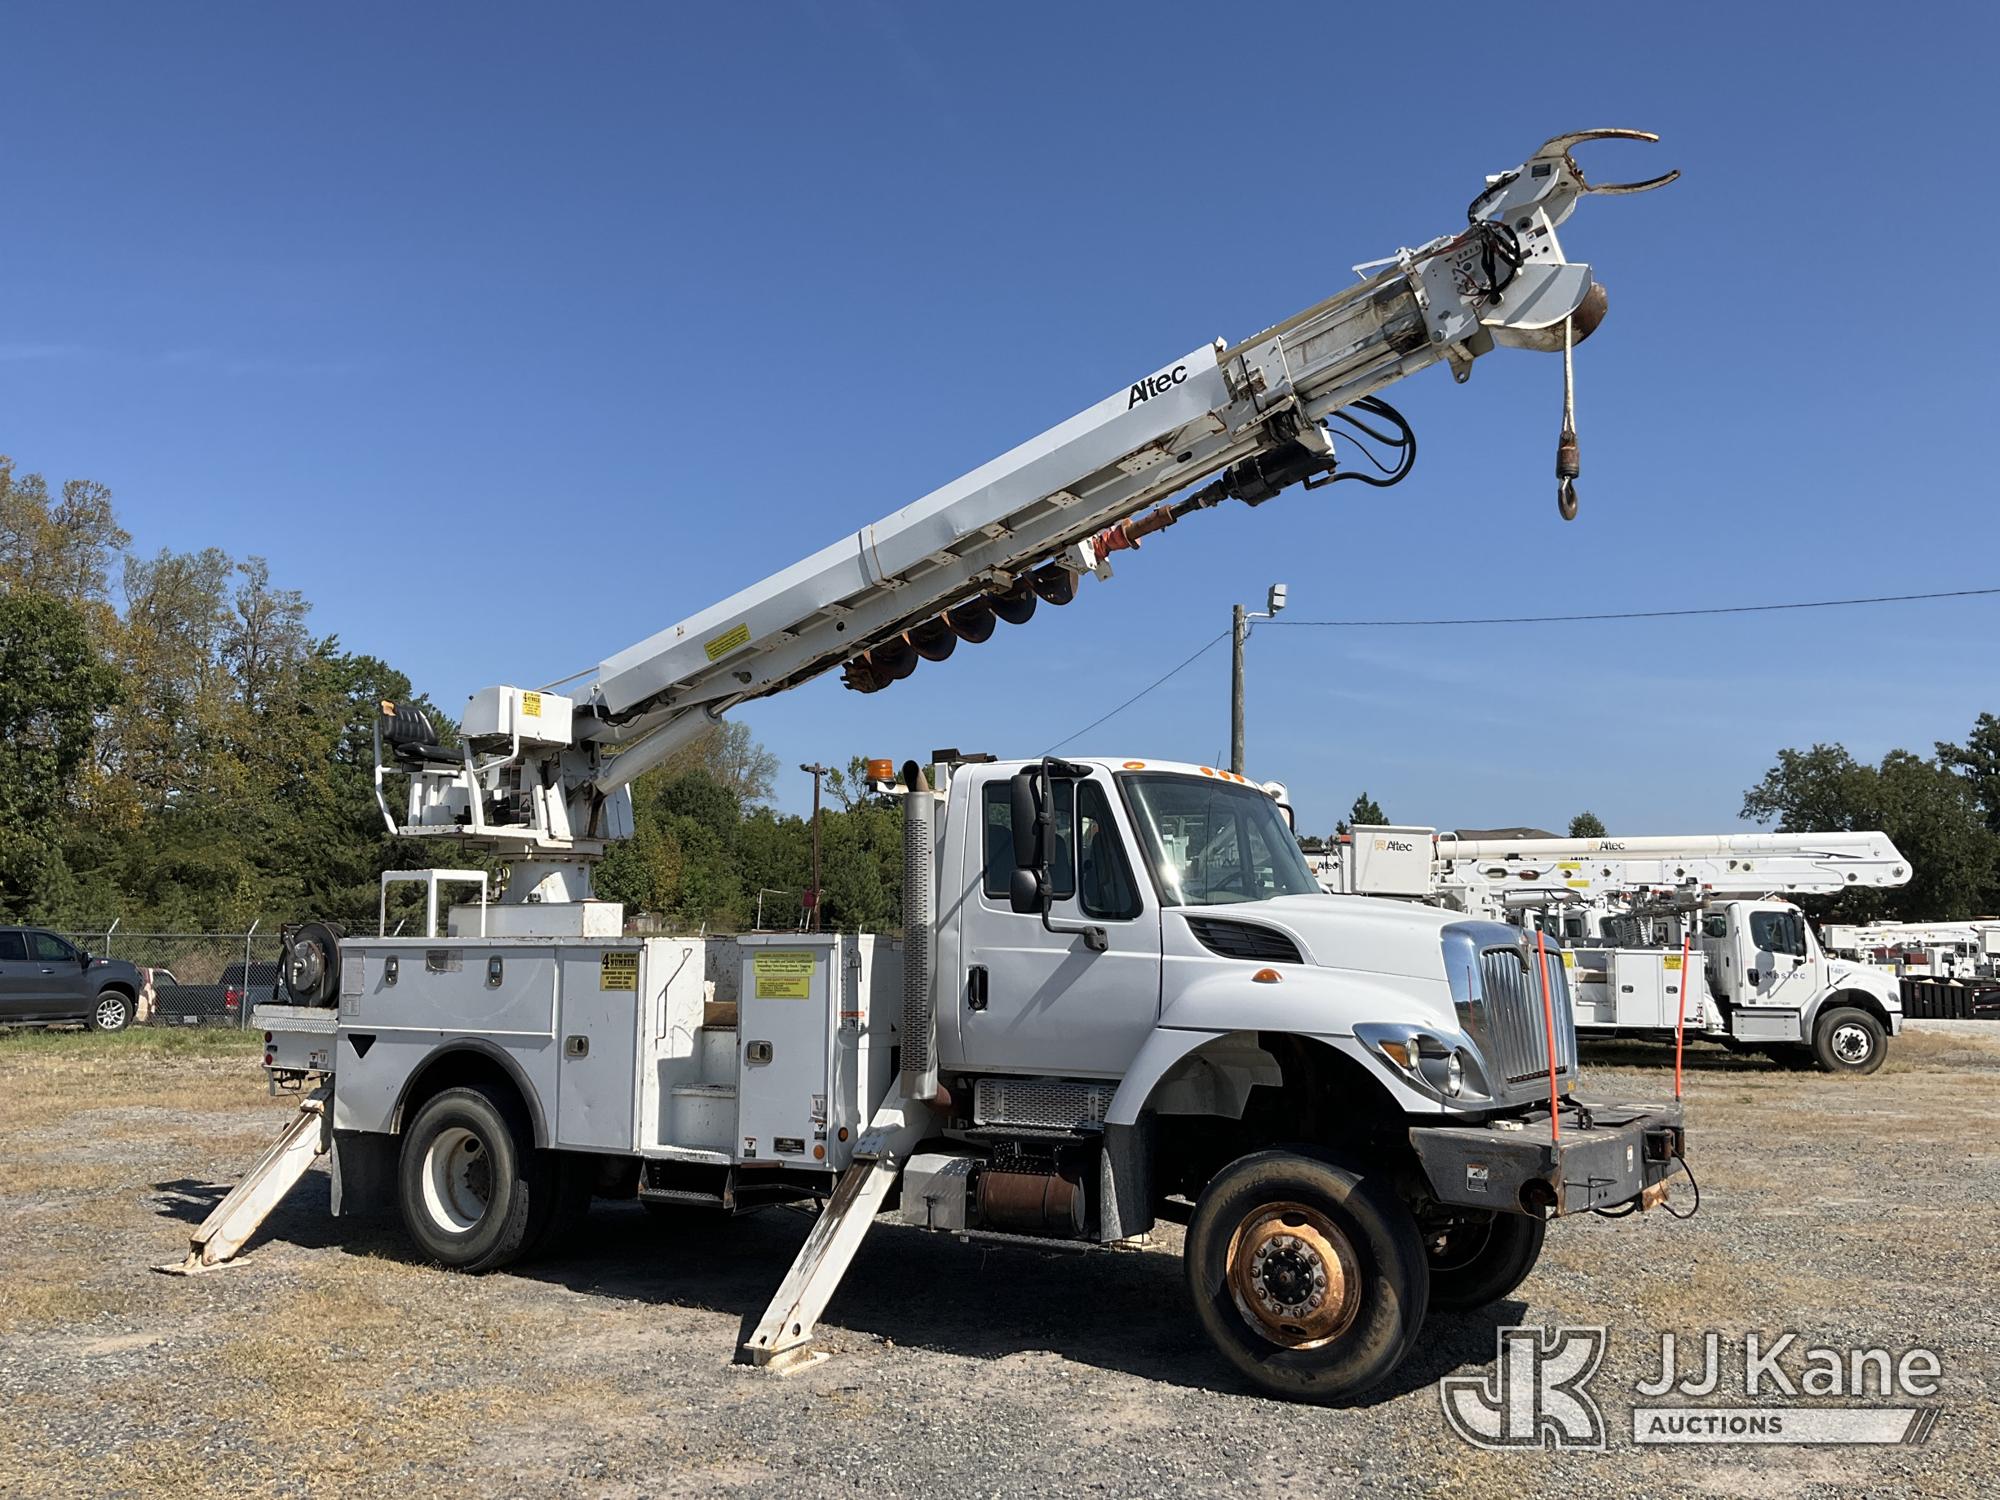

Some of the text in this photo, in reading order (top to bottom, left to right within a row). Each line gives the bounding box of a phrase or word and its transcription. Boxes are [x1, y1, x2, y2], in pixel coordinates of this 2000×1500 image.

[1128, 365, 1188, 410] Altec
[1386, 841, 1413, 851] Altec
[1600, 841, 1625, 850] Altec
[602, 953, 610, 969] 4
